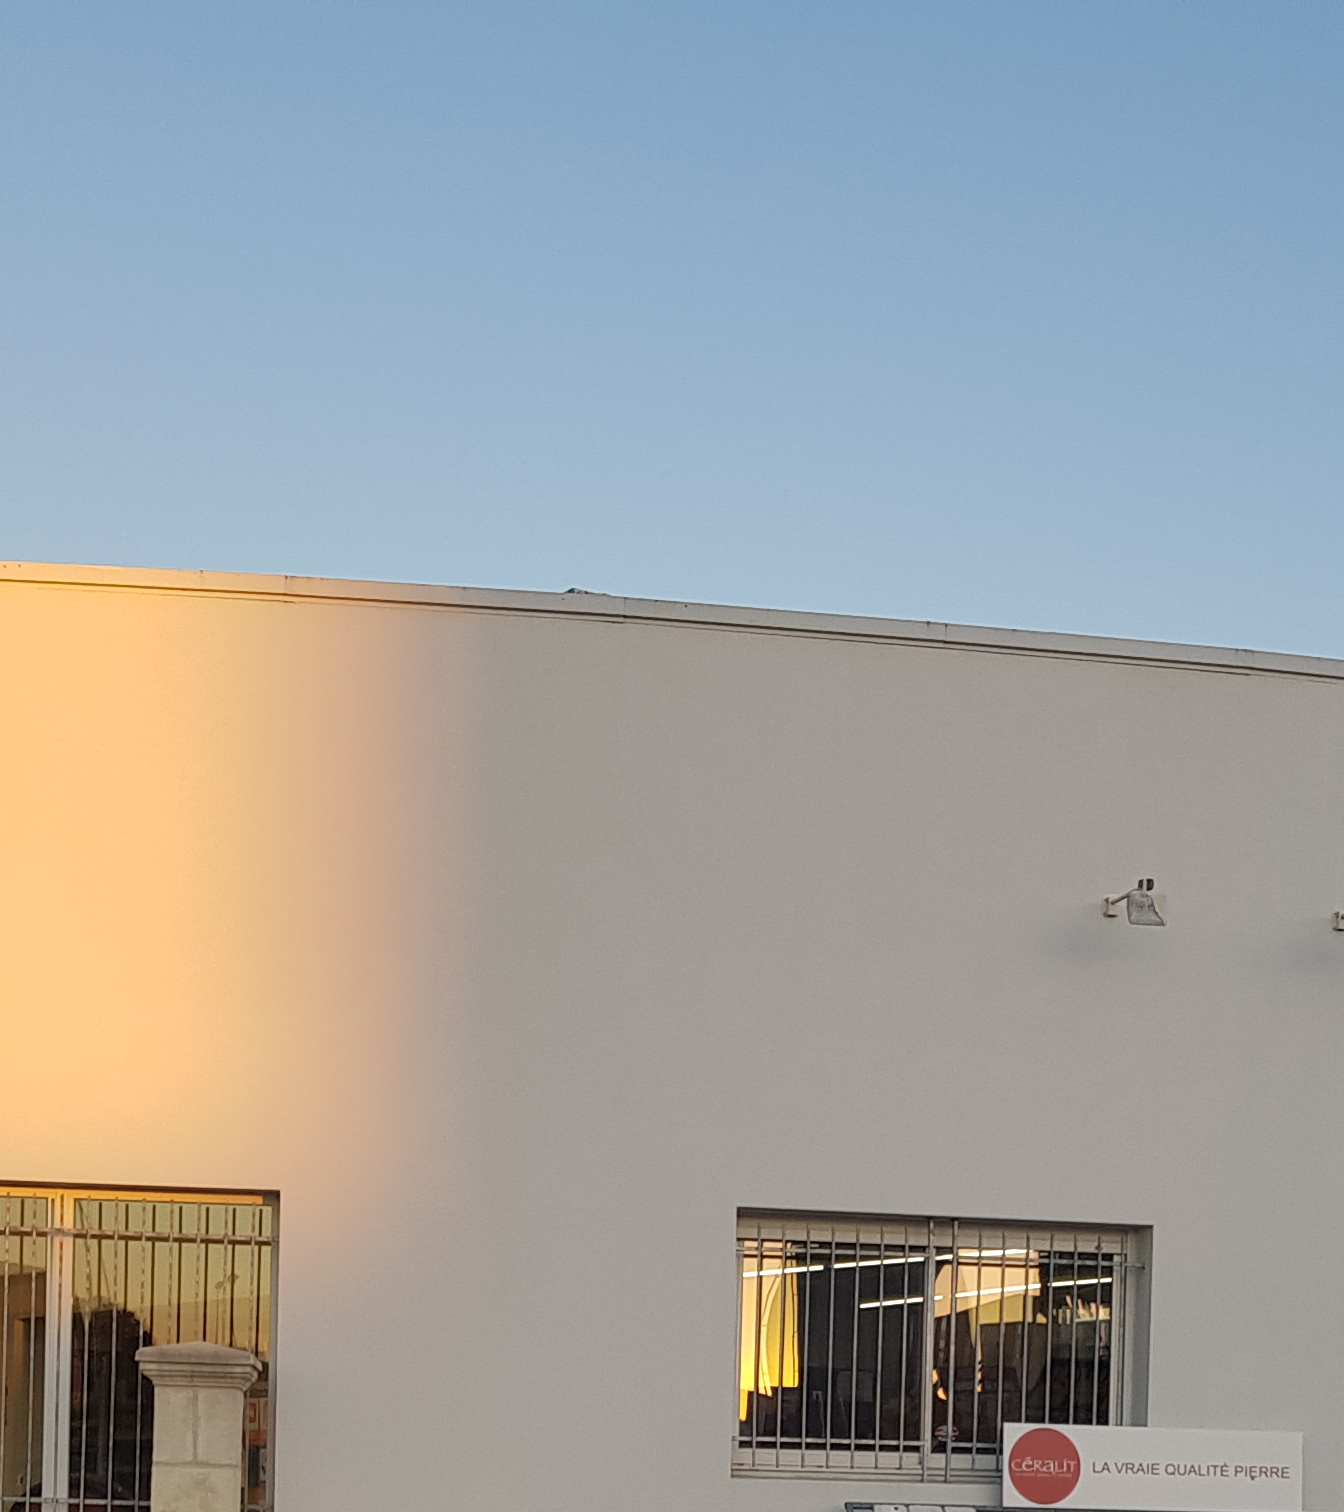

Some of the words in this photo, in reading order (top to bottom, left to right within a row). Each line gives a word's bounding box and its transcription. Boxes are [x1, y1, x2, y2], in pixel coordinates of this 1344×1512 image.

[1092, 1461, 1111, 1474] LA
[1114, 1462, 1160, 1476] VRAIE
[1164, 1462, 1230, 1478] QUALITÉ
[1234, 1465, 1290, 1480] PIERRE
